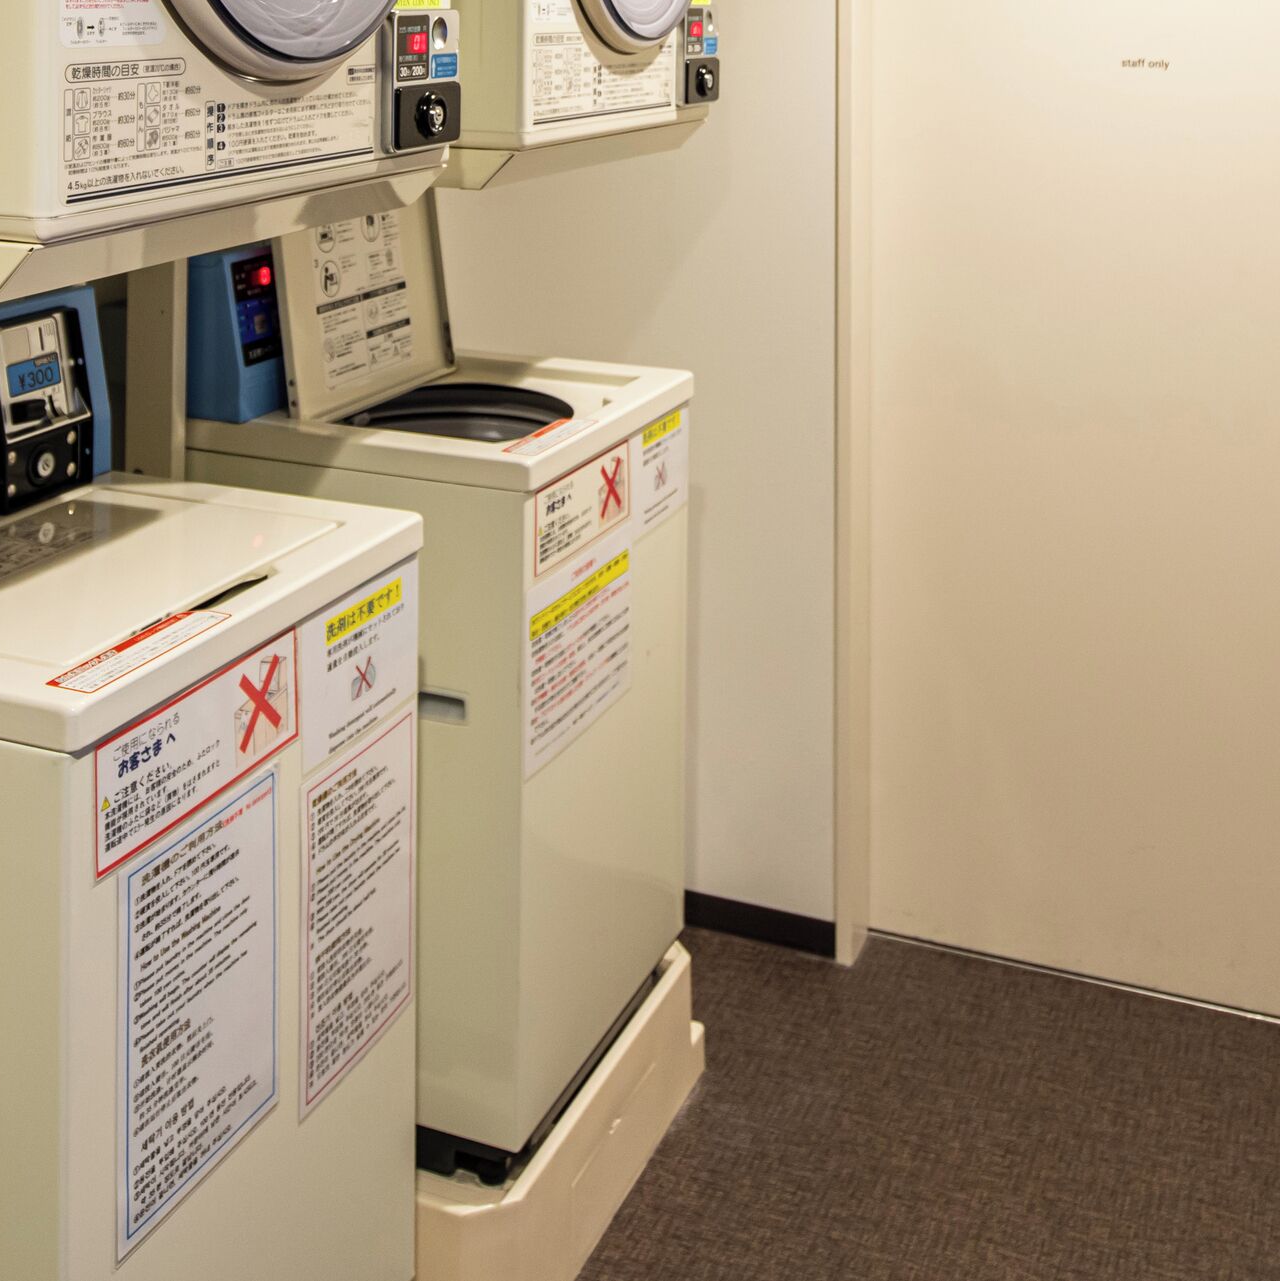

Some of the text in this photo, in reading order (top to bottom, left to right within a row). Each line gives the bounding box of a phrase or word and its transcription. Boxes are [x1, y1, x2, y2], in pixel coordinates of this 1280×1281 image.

[1122, 59, 1169, 71] staff only
[18, 366, 54, 390] ¥300
[118, 733, 176, 779] お客さまへ
